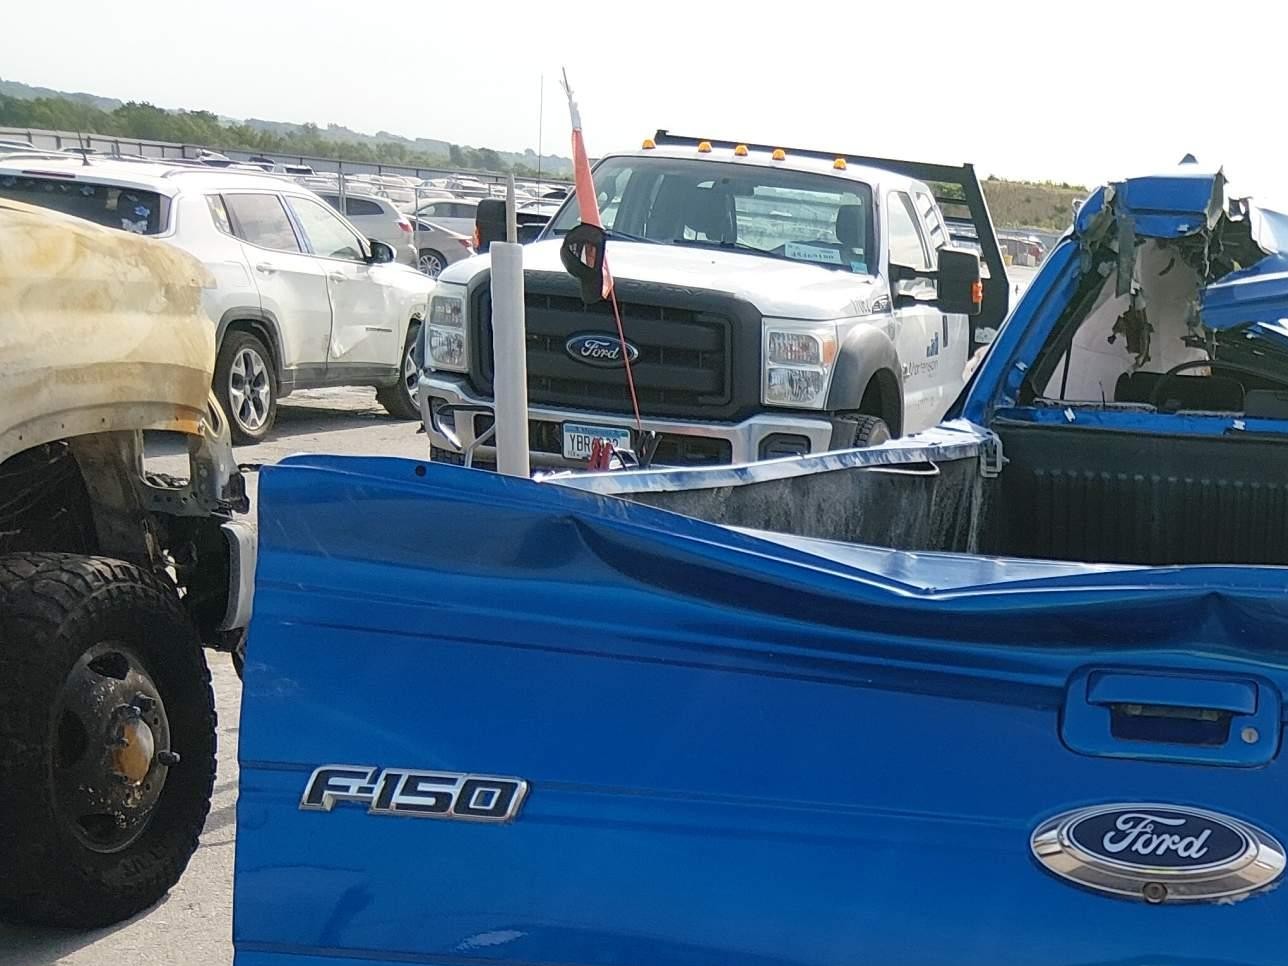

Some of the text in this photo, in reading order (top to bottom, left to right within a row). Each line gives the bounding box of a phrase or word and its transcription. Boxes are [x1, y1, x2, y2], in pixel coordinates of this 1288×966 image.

[581, 339, 620, 359] Ford
[299, 764, 529, 824] F-150
[1102, 812, 1213, 860] Ford
